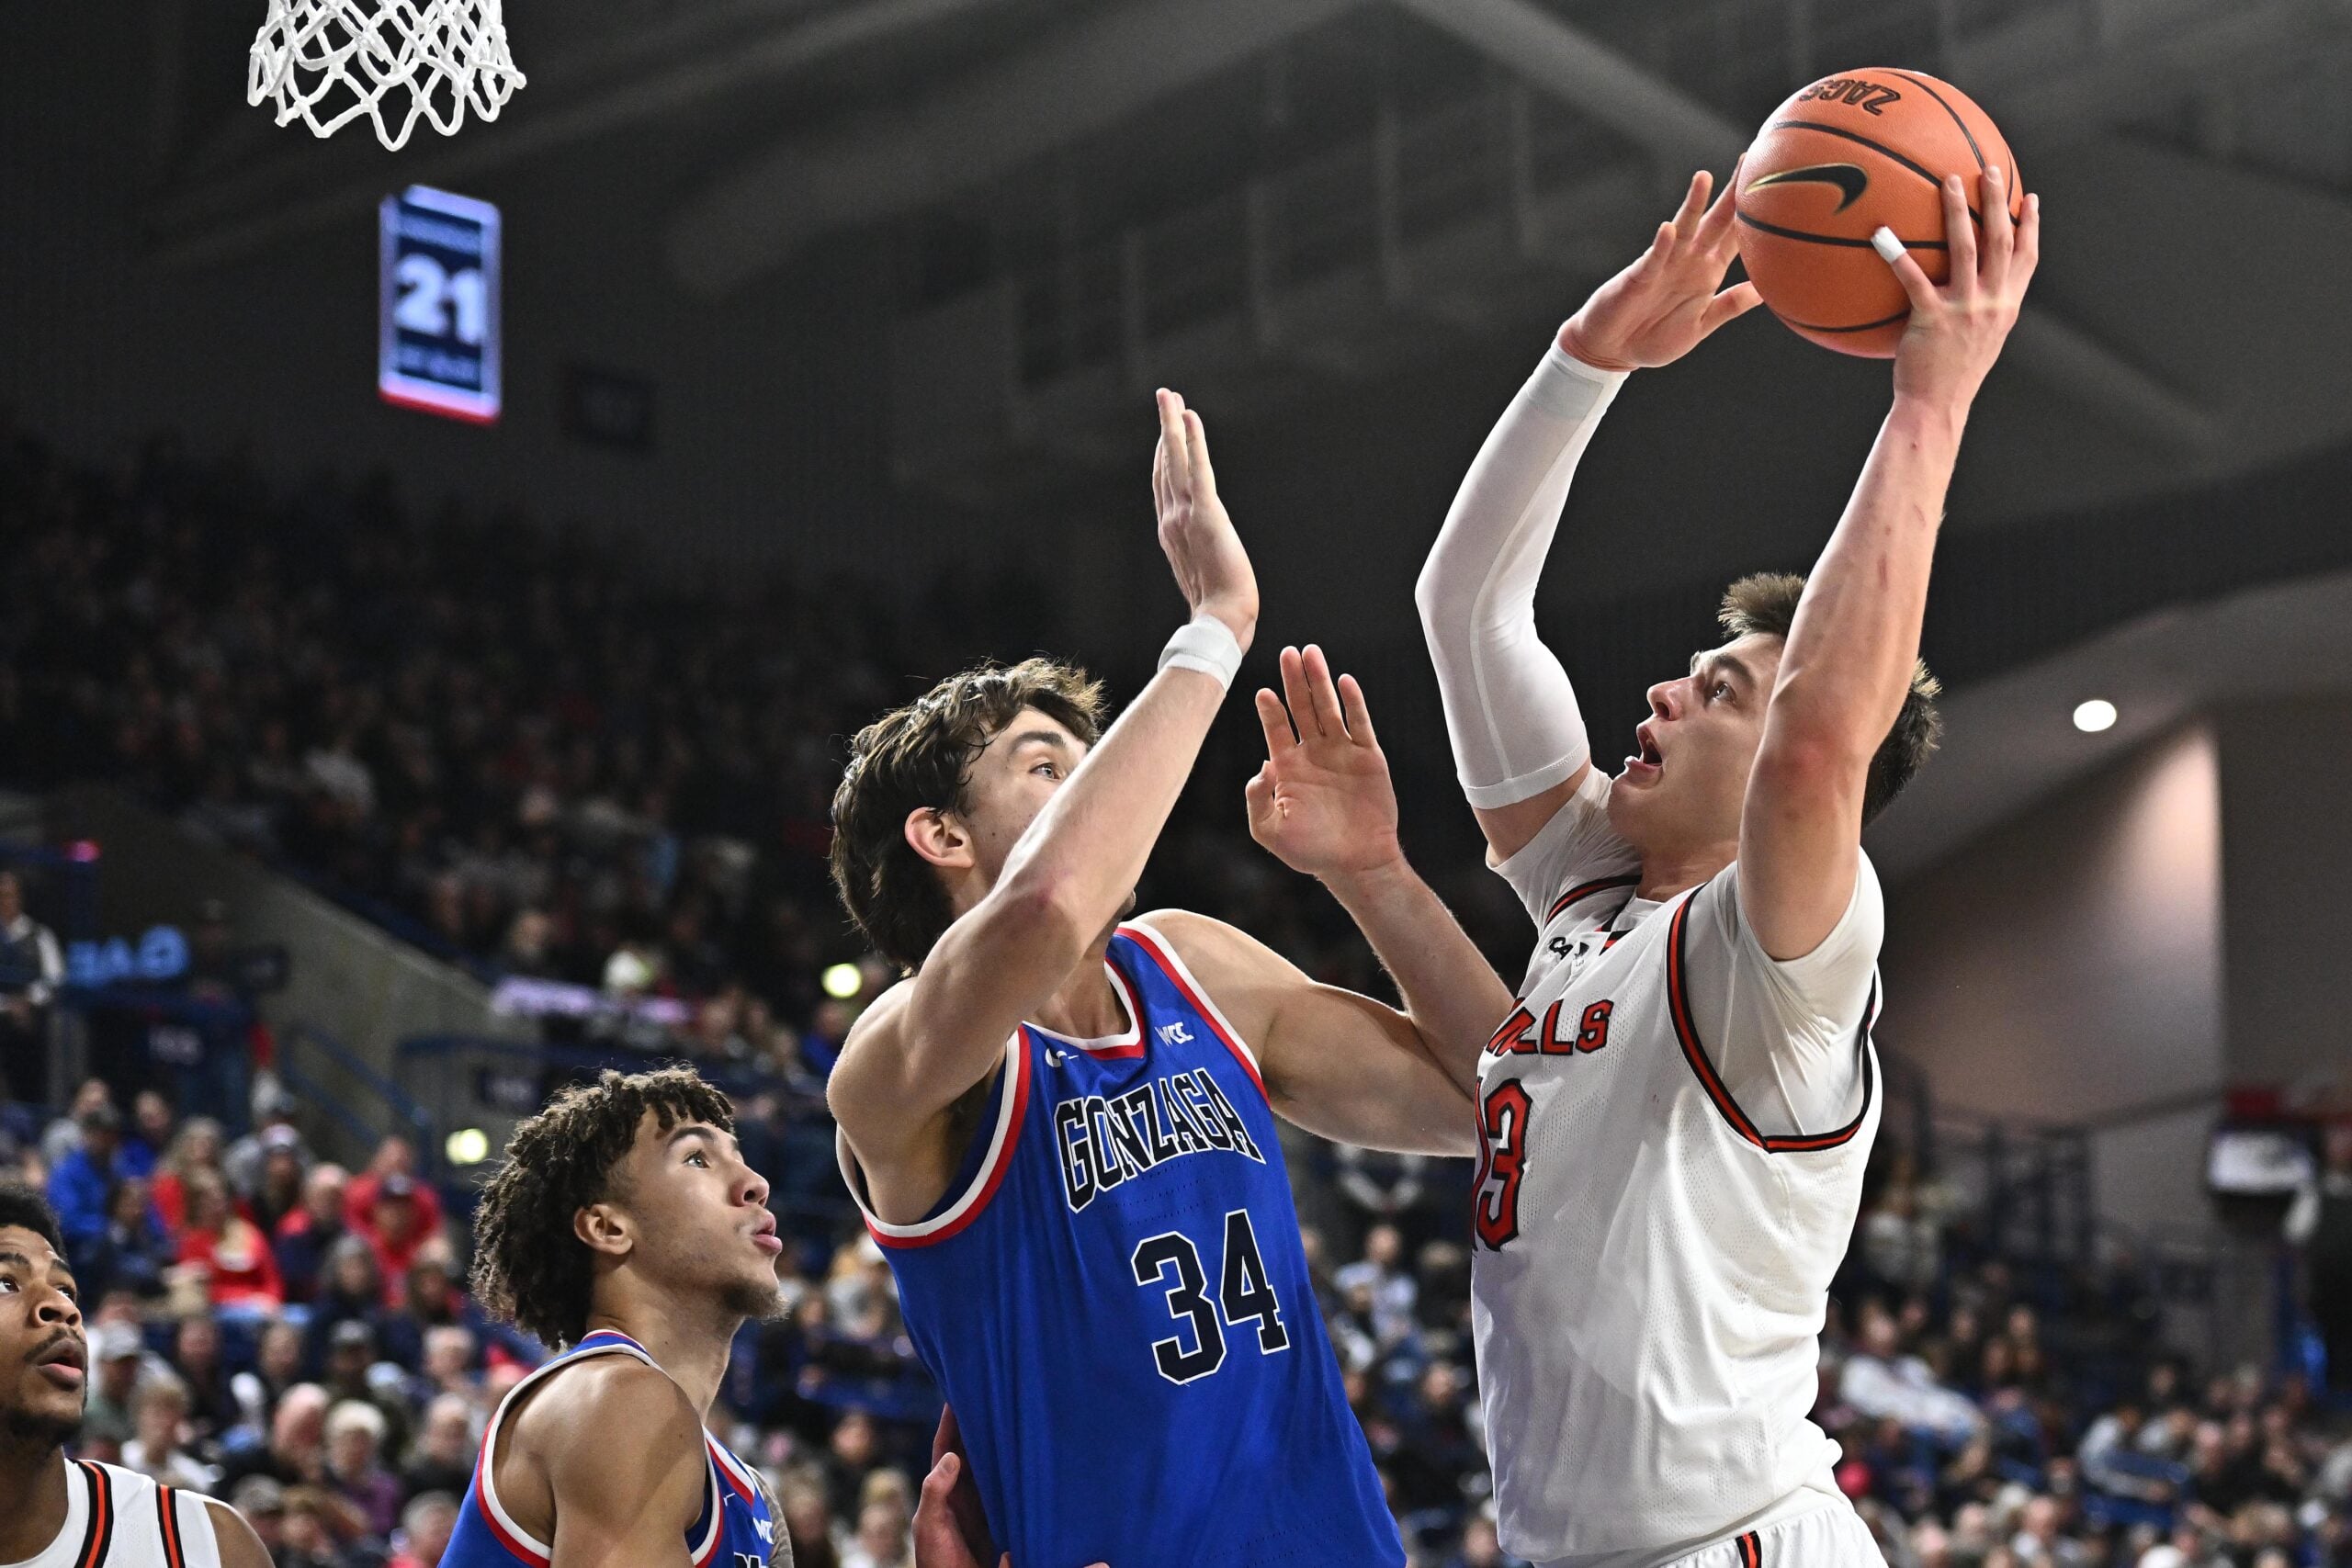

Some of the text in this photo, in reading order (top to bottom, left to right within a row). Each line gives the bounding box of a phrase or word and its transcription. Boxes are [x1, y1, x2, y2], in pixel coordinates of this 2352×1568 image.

[393, 252, 486, 347] 21
[1154, 1021, 1194, 1047] WCC
[1054, 1066, 1267, 1215] GONZAGA
[1130, 1208, 1291, 1386] 34
